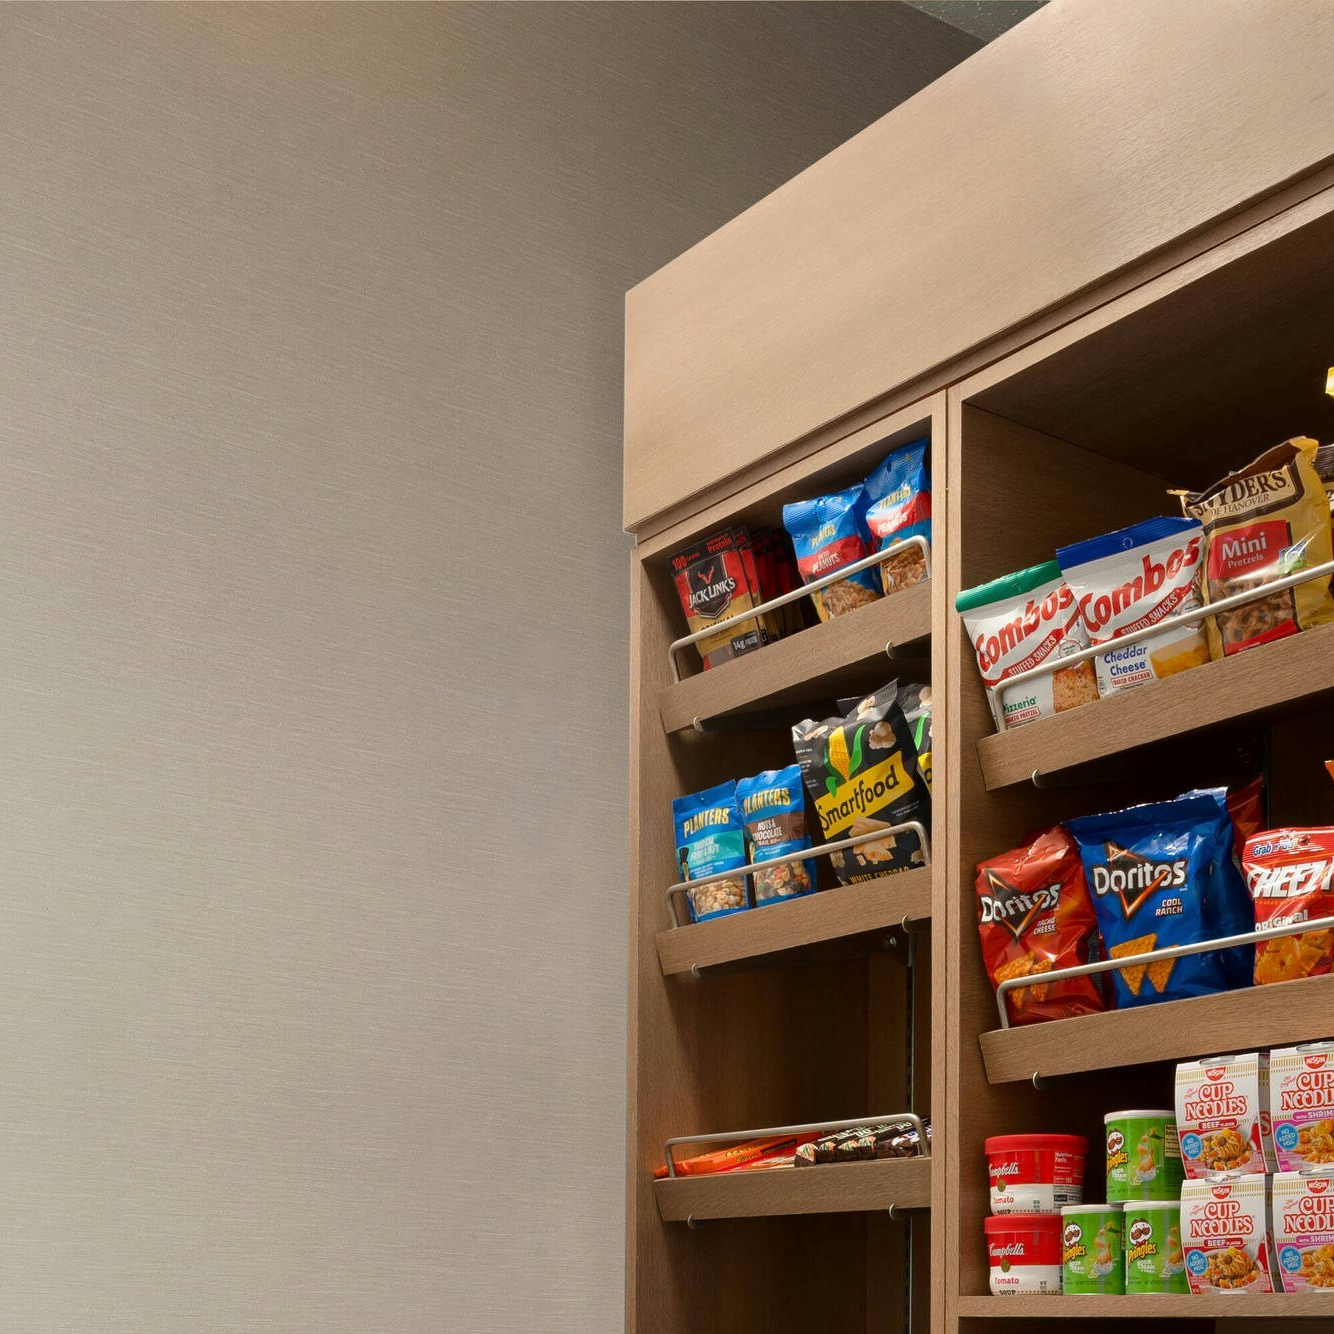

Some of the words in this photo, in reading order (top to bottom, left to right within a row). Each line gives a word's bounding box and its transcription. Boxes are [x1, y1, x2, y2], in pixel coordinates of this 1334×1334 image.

[1223, 493, 1270, 514] HANOVER
[1221, 531, 1267, 561] Mini
[812, 552, 841, 574] PEANUTS
[1227, 553, 1264, 569] Pretzels
[687, 588, 709, 609] JACK
[707, 577, 737, 600] LINK'S
[1078, 536, 1202, 634] Combos
[1148, 594, 1179, 619] SNACKS
[976, 582, 1072, 672] Combos
[1033, 635, 1057, 662] SNACKS
[1103, 645, 1148, 665] Cheddar
[1109, 660, 1147, 677] Cheese
[742, 786, 791, 814] PLANTERS
[817, 764, 901, 833] Smartfood
[682, 807, 731, 838] PLANTERS
[1252, 842, 1272, 857] Grab
[1092, 860, 1187, 894] Doritos
[980, 883, 1062, 923] Doritos
[1154, 905, 1183, 917] RANCH
[1161, 897, 1182, 908] COOL
[1033, 924, 1056, 935] CHEESE
[1198, 1081, 1234, 1101] CUP
[1184, 1096, 1248, 1122] NOODLES
[1201, 1121, 1221, 1129] BEEF
[1203, 1199, 1241, 1219] CUP
[1190, 1215, 1254, 1239] NOODLES
[1207, 1239, 1226, 1247] BEEF
